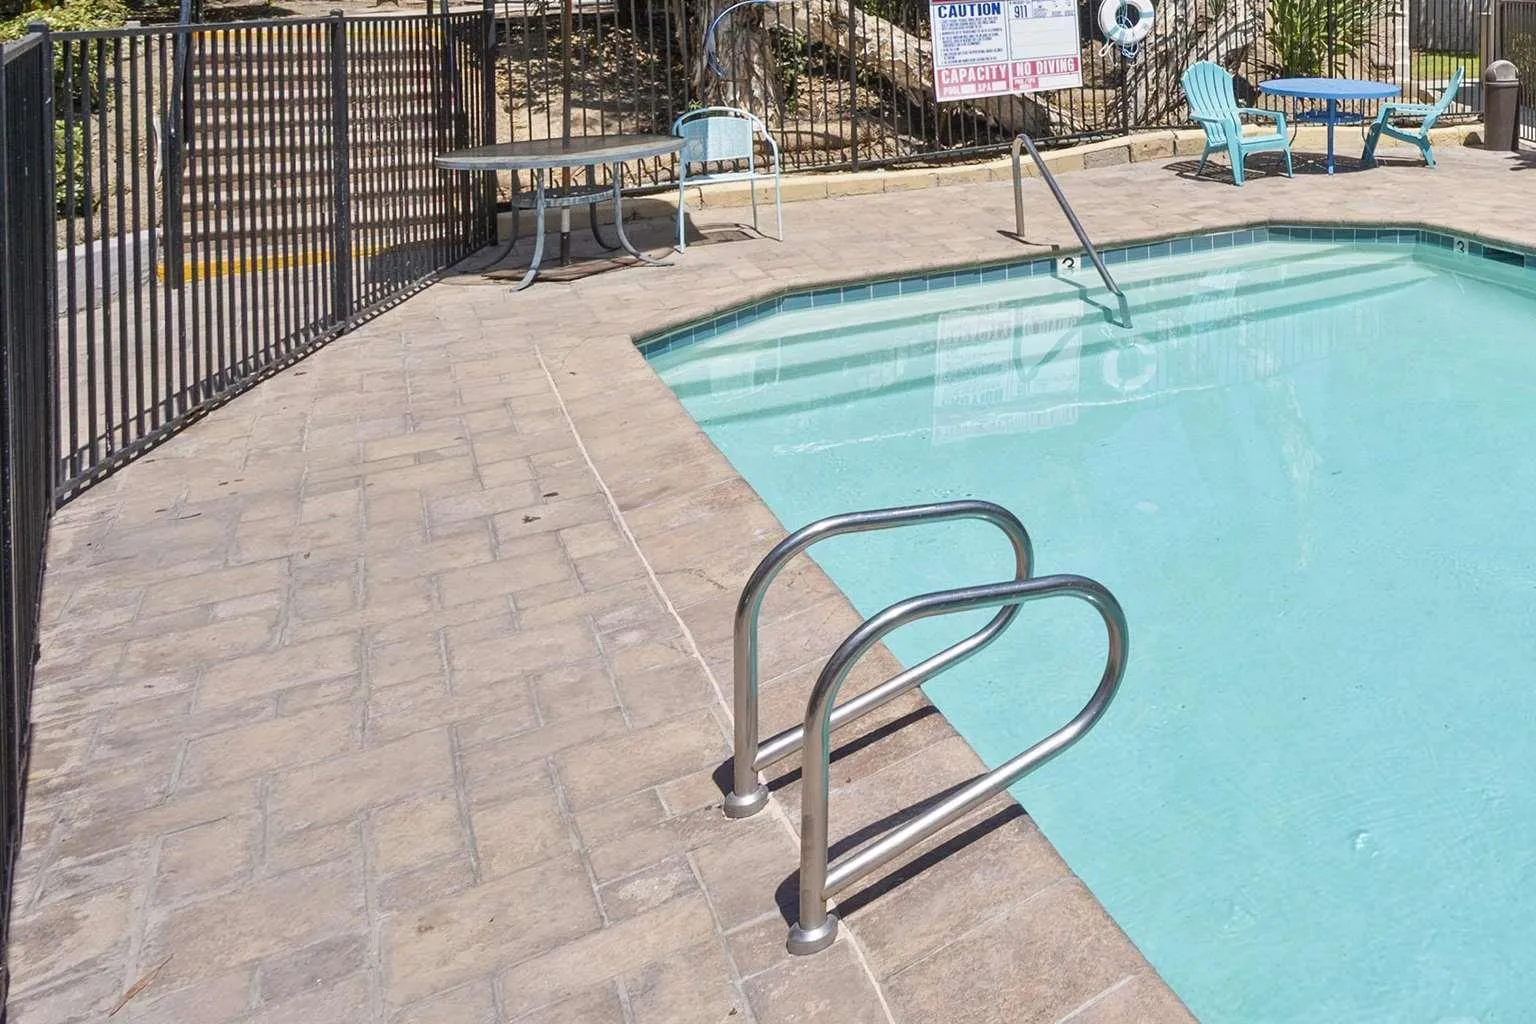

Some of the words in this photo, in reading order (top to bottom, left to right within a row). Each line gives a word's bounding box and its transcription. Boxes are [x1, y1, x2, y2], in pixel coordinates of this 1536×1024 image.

[937, 2, 1001, 19] CAUTION
[1014, 4, 1028, 18] 911
[941, 64, 1007, 85] CAPACITY
[1016, 61, 1032, 77] NO
[1036, 59, 1075, 75] DIVING
